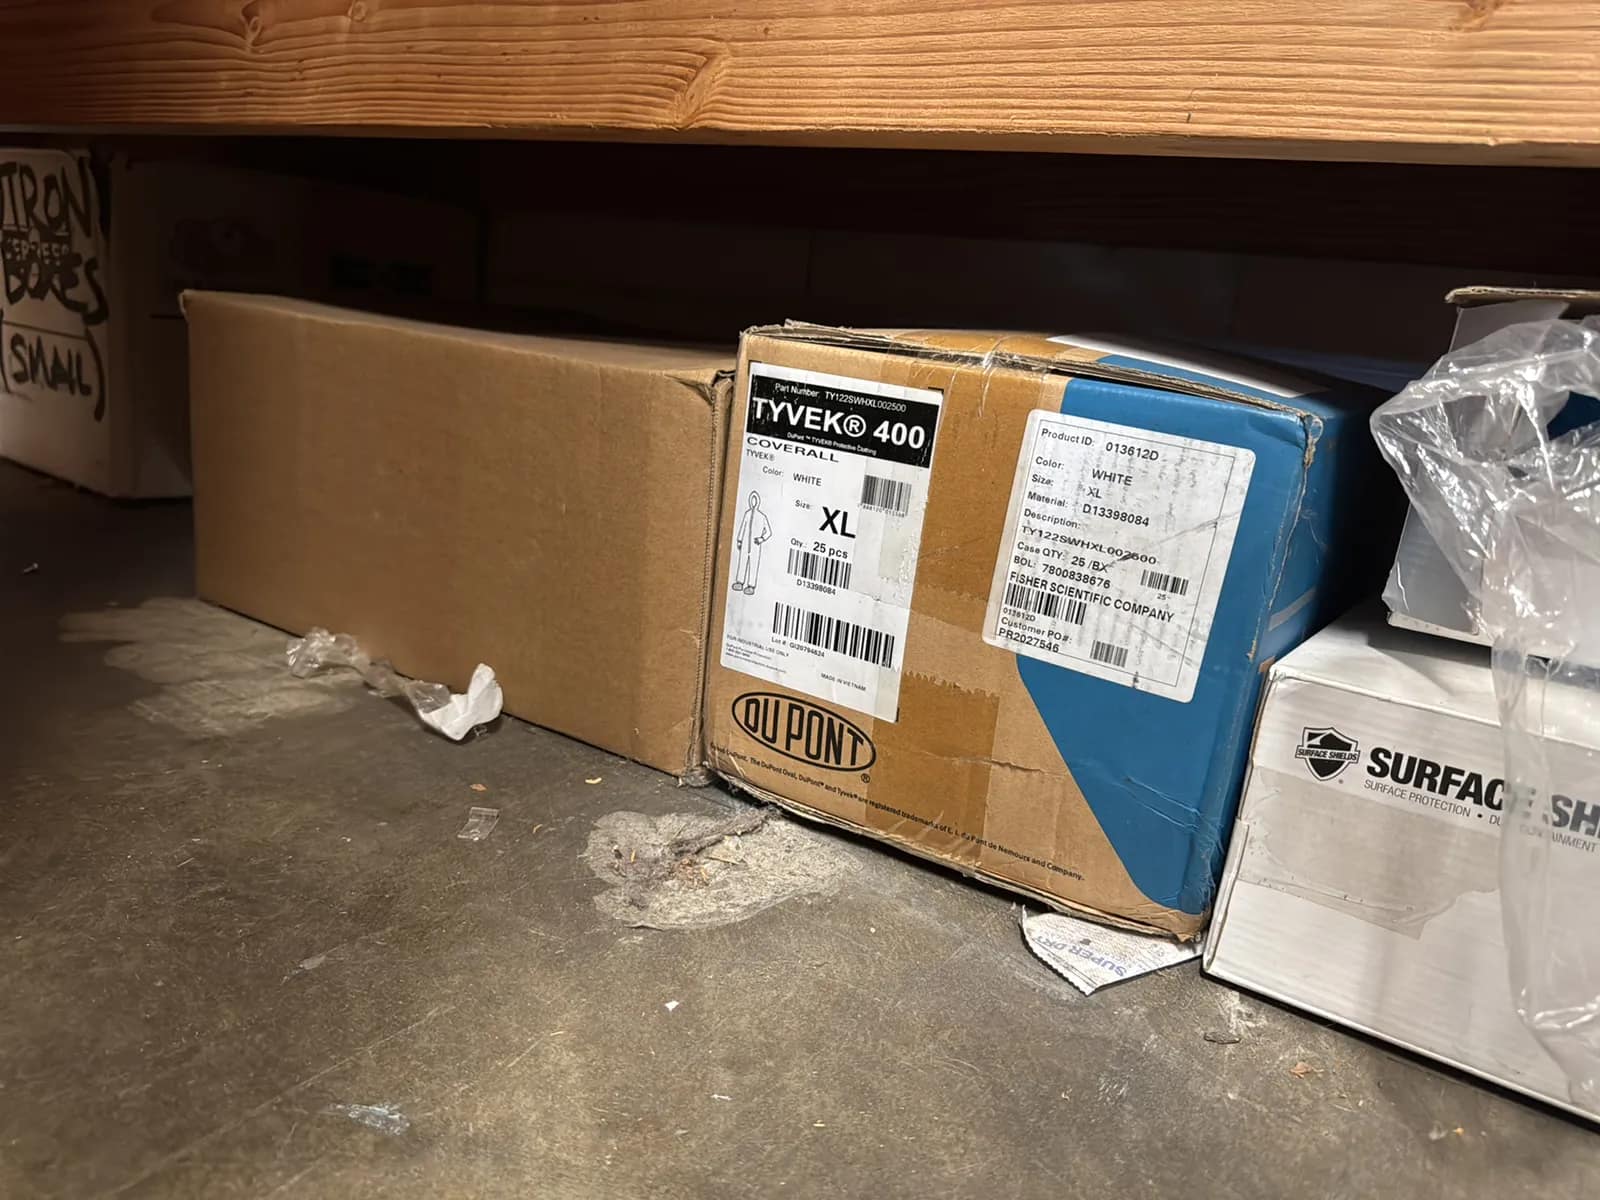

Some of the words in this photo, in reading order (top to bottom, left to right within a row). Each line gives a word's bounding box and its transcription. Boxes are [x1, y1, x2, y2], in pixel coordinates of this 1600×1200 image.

[775, 382, 790, 394] Part
[752, 396, 866, 438] TYVEK®
[873, 420, 925, 449] 400
[746, 436, 840, 463] COVERALL
[746, 449, 775, 462] TYVEK®
[1041, 428, 1080, 444] Product
[1080, 436, 1095, 446] ID:
[1105, 441, 1160, 461] 013612D
[762, 466, 784, 478] Color:
[792, 472, 822, 487] WHITE
[1035, 456, 1064, 470] Color:
[1092, 468, 1134, 486] WHITE
[1031, 474, 1054, 486] Size:
[1086, 486, 1102, 500] XL
[819, 506, 856, 539] XL
[1024, 508, 1081, 530] Description:
[1027, 490, 1069, 509] Material:
[1082, 504, 1150, 528] D13398084
[812, 541, 826, 554] 25
[828, 545, 848, 560] pcs
[1017, 541, 1040, 555] Case
[1042, 547, 1066, 560] QTY:
[1071, 556, 1086, 567] 25
[1087, 559, 1110, 574] /BX
[1013, 556, 1037, 568] BOL:
[1042, 563, 1111, 589] 7800838676
[796, 578, 836, 596] D13398084
[1009, 571, 1048, 590] FISHER
[1050, 582, 1112, 607] SCIENTIFIC
[1114, 598, 1174, 623] COMPANY
[1002, 606, 1036, 622] 013612D
[771, 636, 781, 644] Lot
[998, 628, 1060, 653] PR2027546
[1000, 617, 1046, 636] Customer
[1047, 628, 1072, 644] PO#:
[821, 672, 836, 682] MADE
[843, 679, 866, 692] VIETNAM
[1298, 749, 1328, 758] SURFACE
[1328, 751, 1358, 761] SHIELDS
[1364, 780, 1406, 800] SURFACE
[1408, 792, 1472, 818] PROTECTION
[750, 756, 761, 766] The
[761, 761, 783, 774] DuPont
[782, 768, 798, 780] Oval,
[824, 784, 836, 793] and
[858, 796, 868, 804] are
[868, 799, 901, 817] registered
[988, 842, 998, 850] de
[998, 845, 1030, 862] Nemours
[1031, 857, 1046, 868] and
[1046, 862, 1086, 881] Company.
[1068, 946, 1127, 977] SUPER
